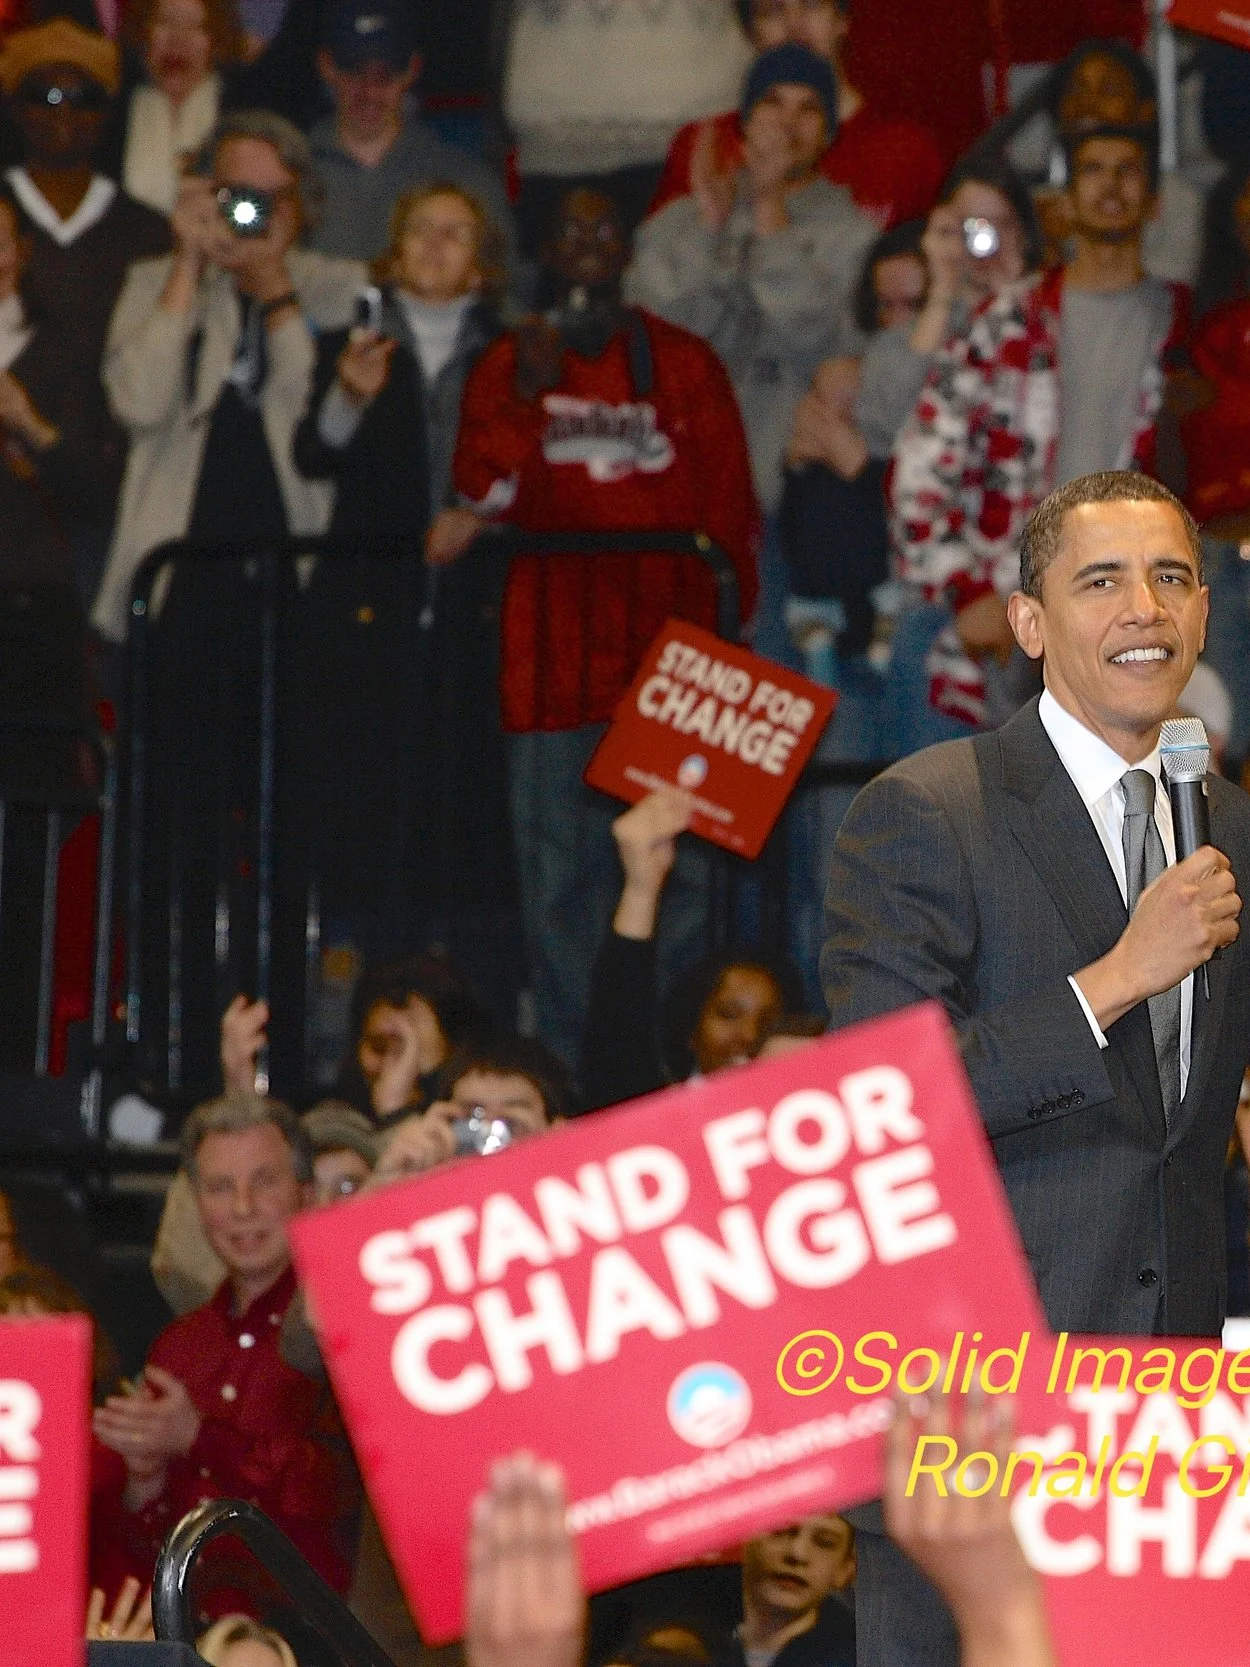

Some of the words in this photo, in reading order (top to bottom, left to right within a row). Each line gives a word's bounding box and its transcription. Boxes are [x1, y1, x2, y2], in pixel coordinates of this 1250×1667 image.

[637, 673, 800, 777] CHANGE
[656, 639, 752, 705] STAND
[750, 679, 816, 736] FOR
[357, 1143, 692, 1317] STAND
[701, 1063, 924, 1201] FOR
[389, 1144, 960, 1417] CHANGE
